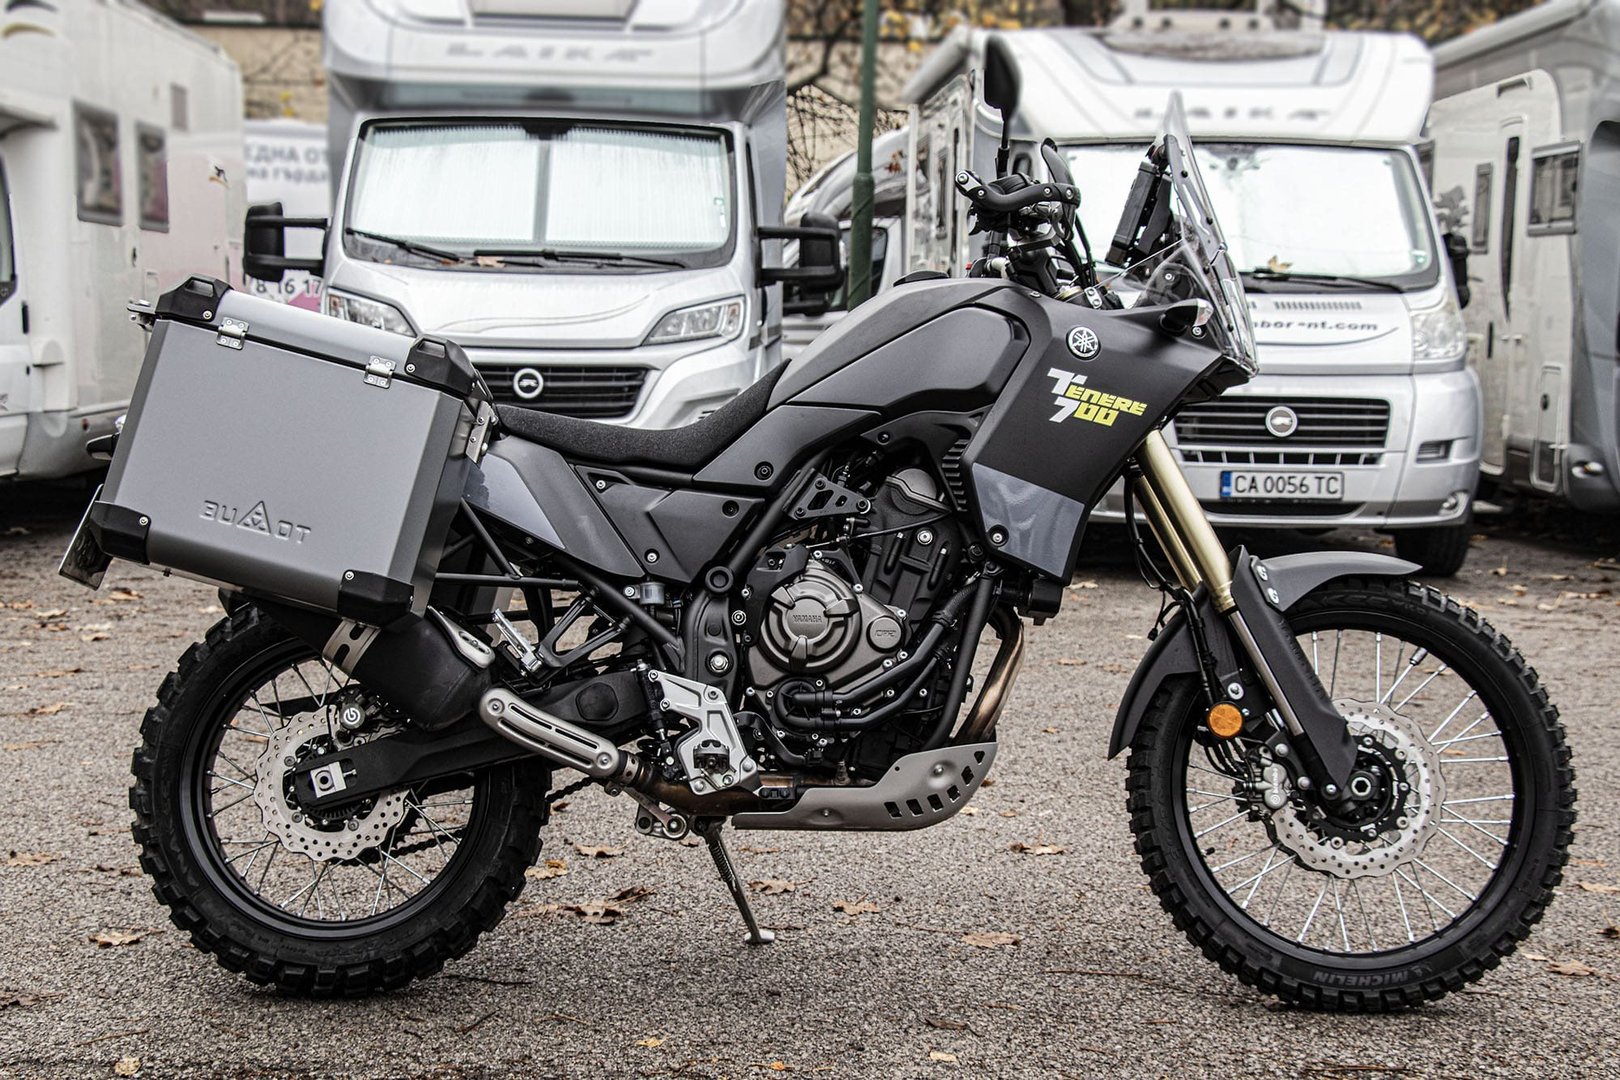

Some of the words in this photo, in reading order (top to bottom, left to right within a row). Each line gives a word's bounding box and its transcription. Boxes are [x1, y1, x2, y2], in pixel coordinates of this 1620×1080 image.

[303, 279, 322, 294] 17
[1049, 396, 1120, 427] 700
[1234, 475, 1259, 494] CA
[1263, 475, 1310, 494] 0056
[1315, 476, 1339, 495] TC
[1313, 969, 1409, 987] MICHELIN
